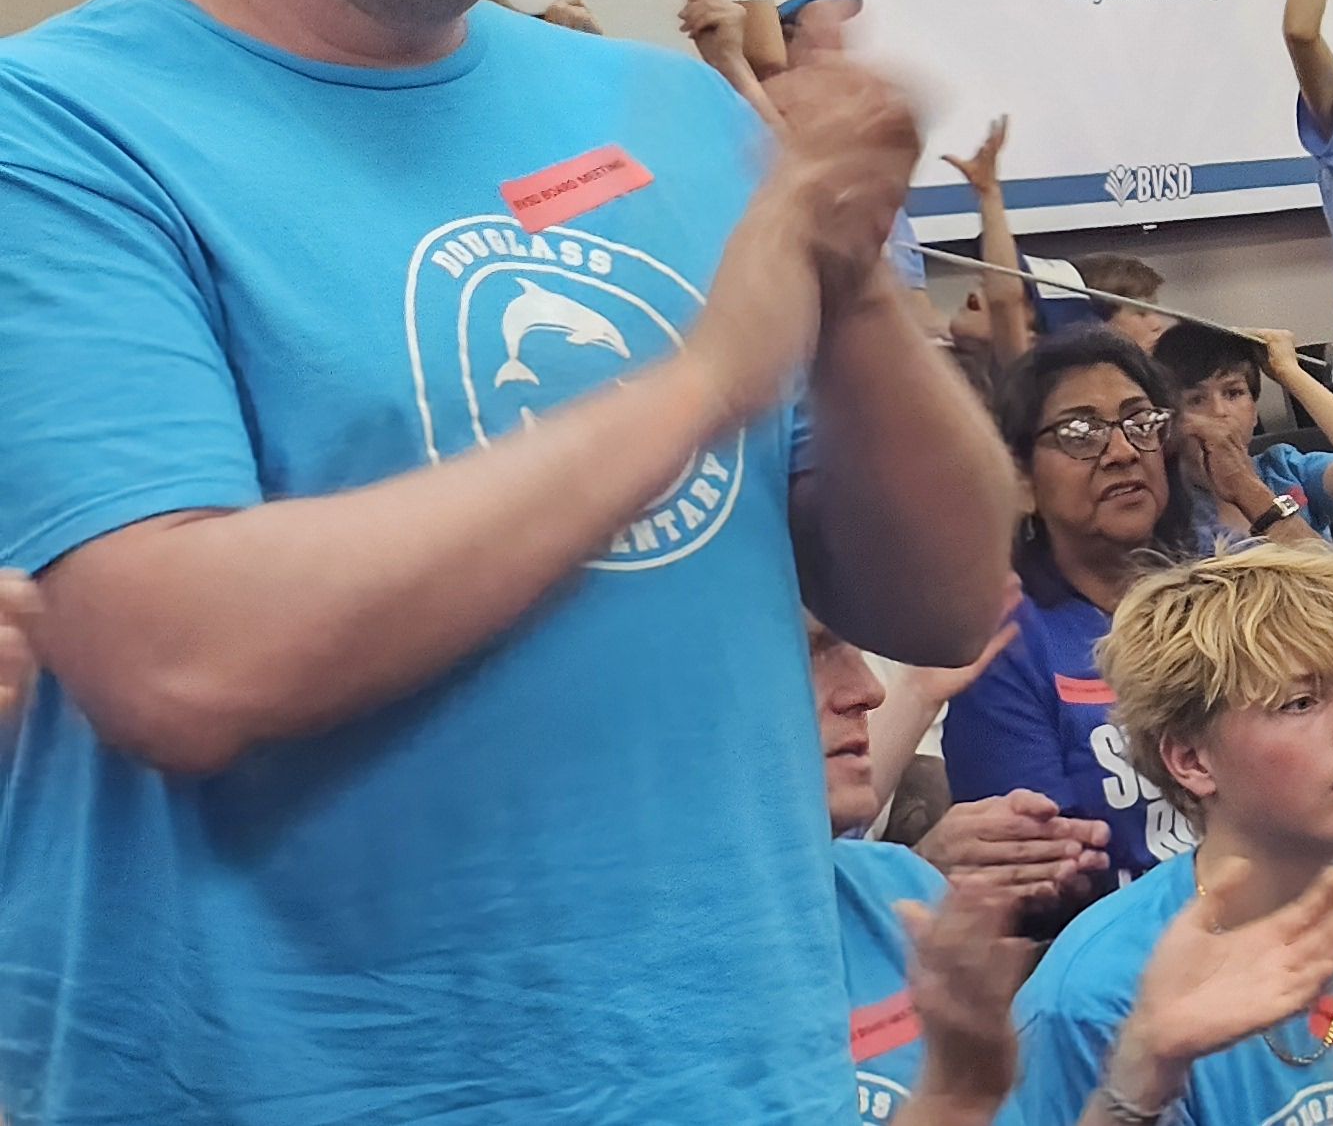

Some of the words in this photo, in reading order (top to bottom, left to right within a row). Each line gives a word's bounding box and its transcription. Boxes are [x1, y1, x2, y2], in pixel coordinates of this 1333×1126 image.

[1136, 162, 1194, 204] BVSD
[430, 227, 613, 279] DOUGLASS
[608, 451, 730, 555] ENTARY
